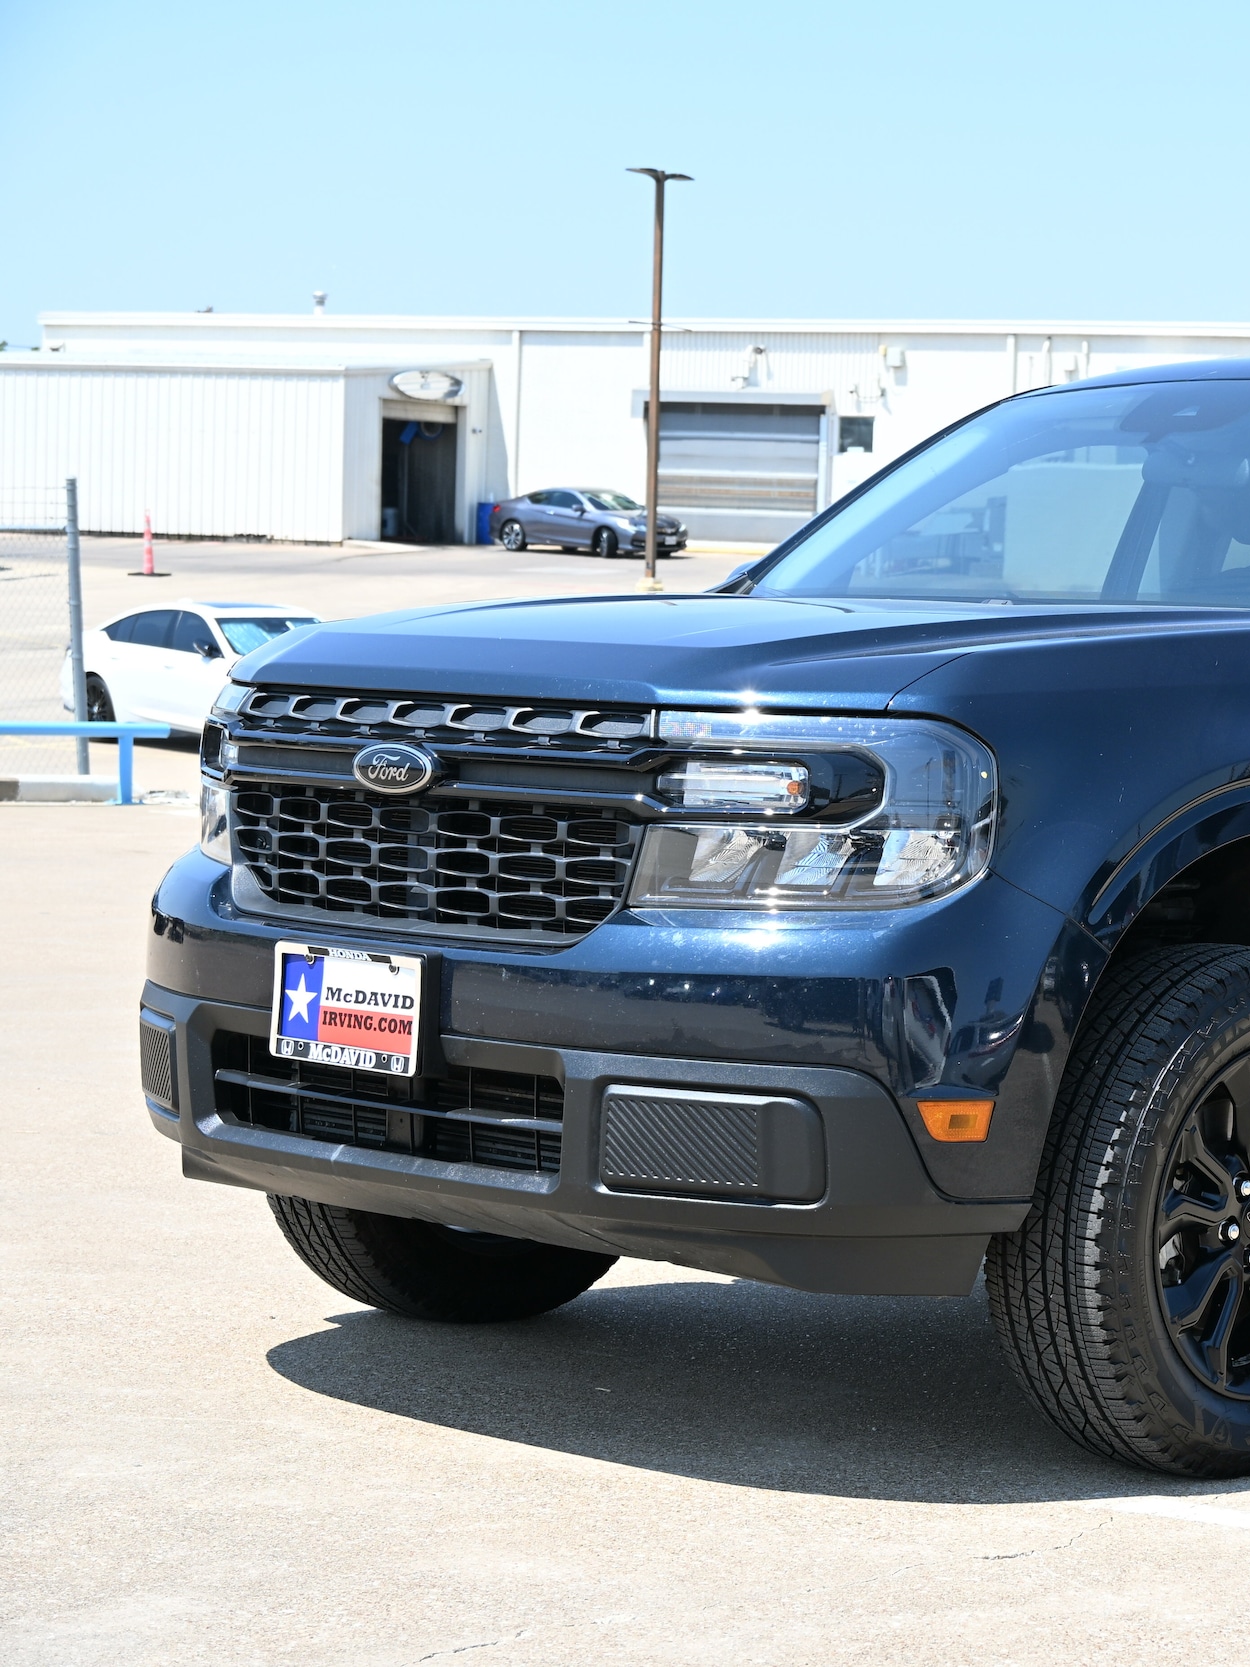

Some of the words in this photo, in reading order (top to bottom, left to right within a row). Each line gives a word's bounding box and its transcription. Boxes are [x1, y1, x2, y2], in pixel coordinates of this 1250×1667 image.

[367, 753, 411, 782] Ford
[328, 948, 372, 962] HONDA
[325, 986, 415, 1010] McDAVID
[322, 1010, 412, 1036] IRVING.COM
[308, 1043, 376, 1068] McDAVID
